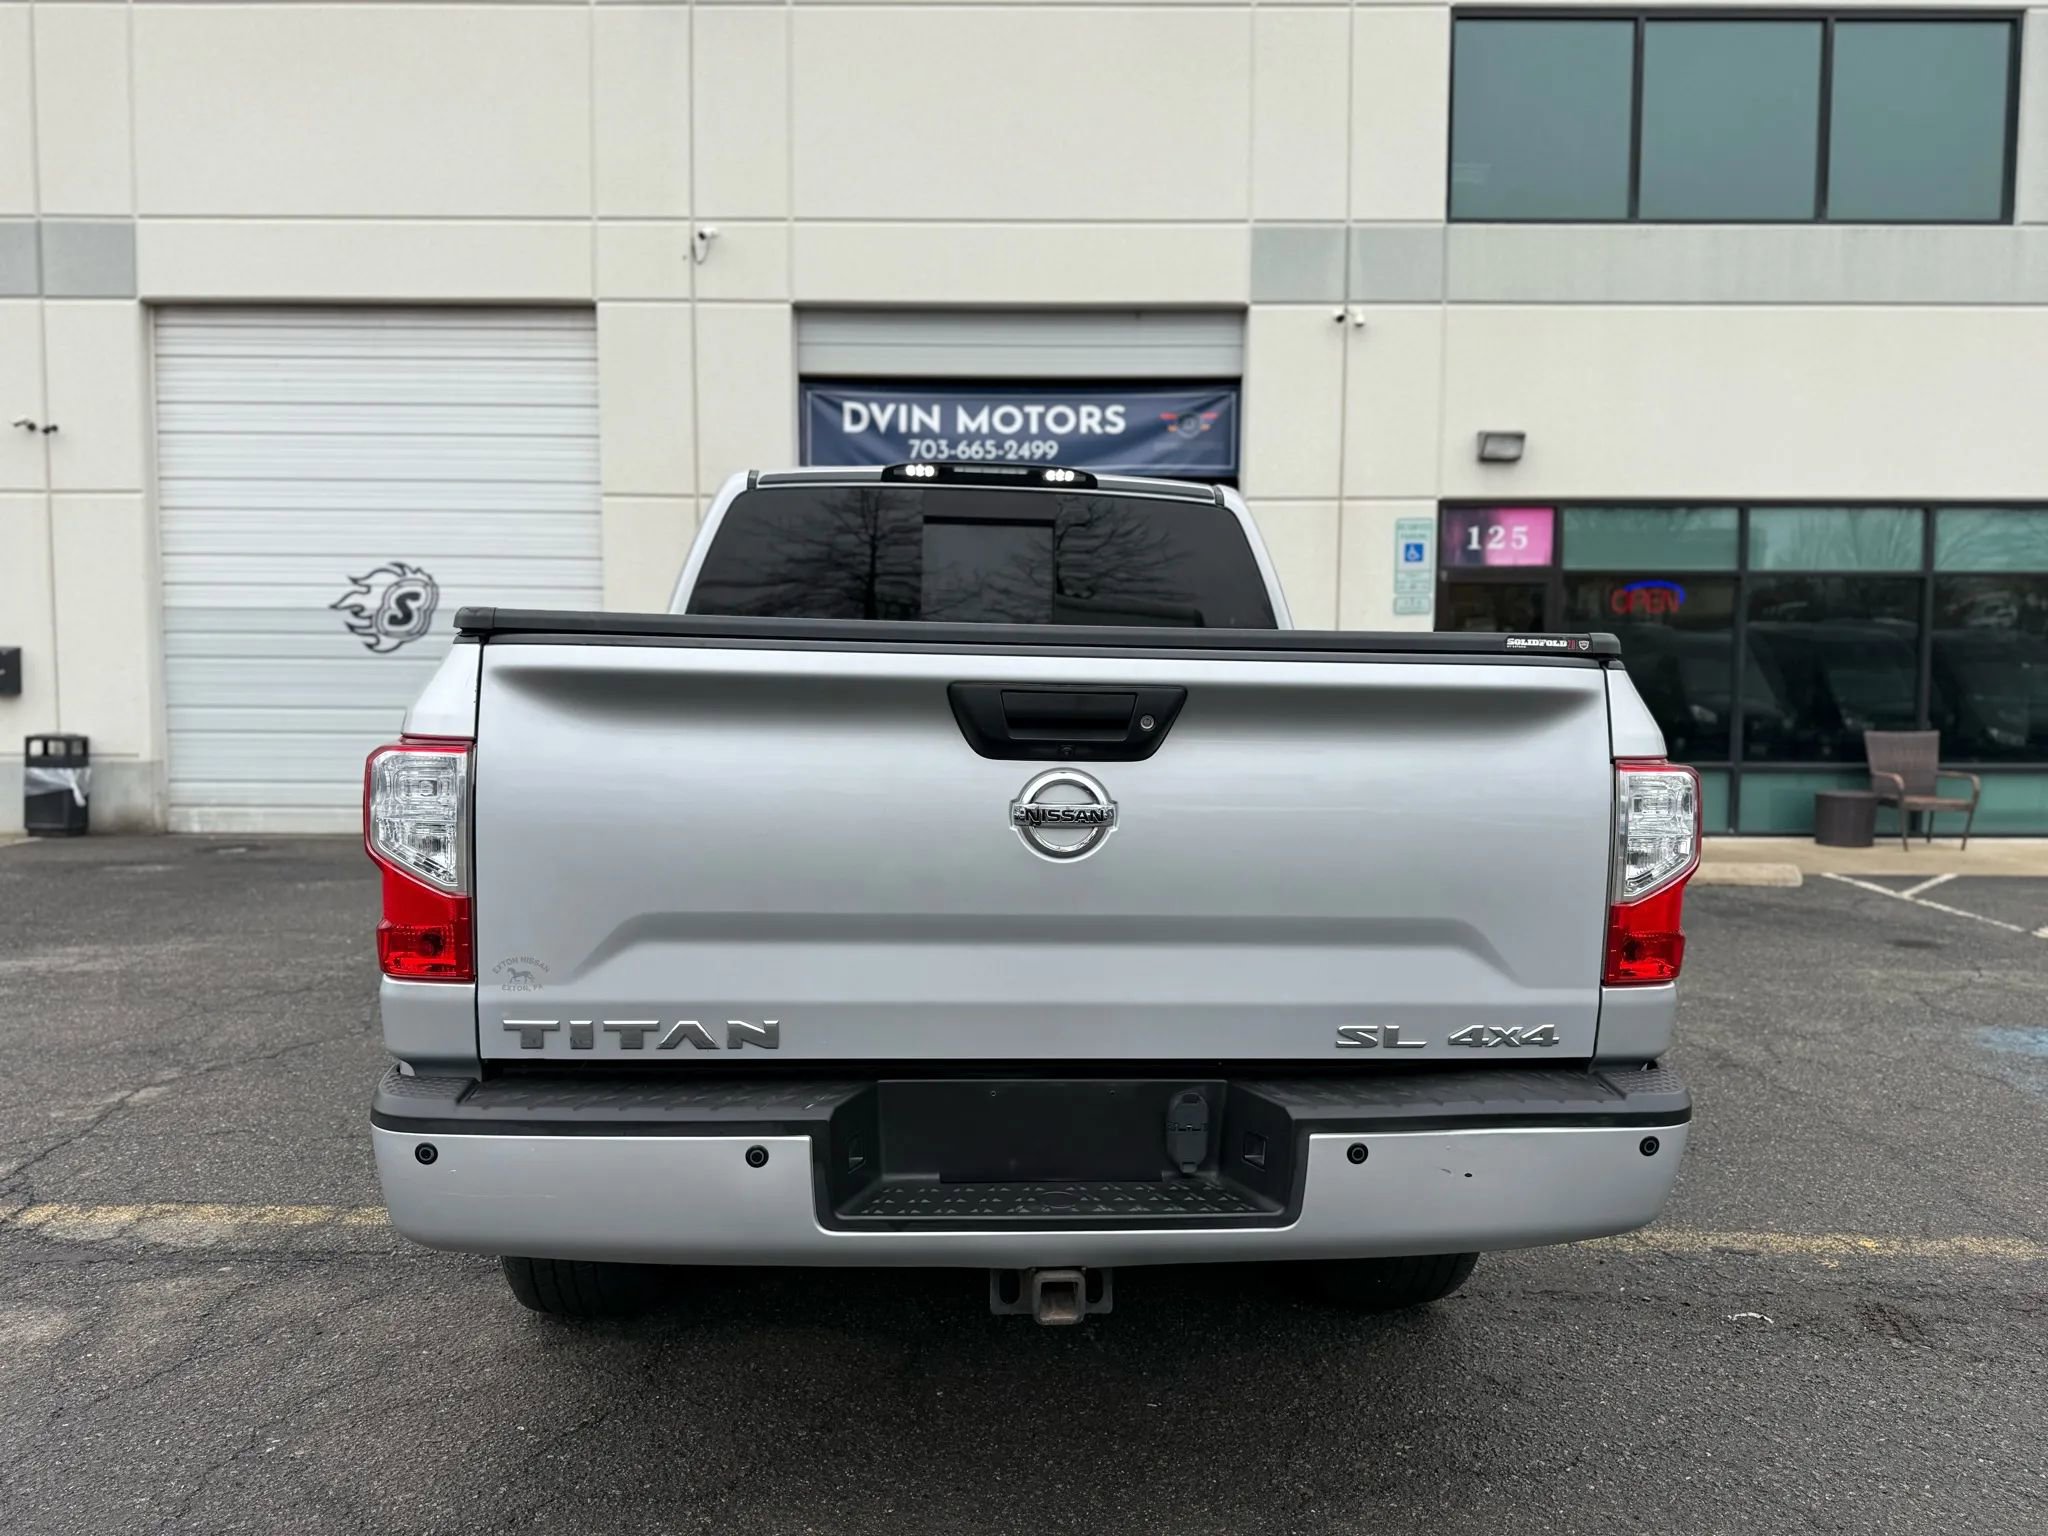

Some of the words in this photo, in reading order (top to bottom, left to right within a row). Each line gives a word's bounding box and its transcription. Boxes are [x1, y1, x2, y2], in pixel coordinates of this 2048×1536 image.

[842, 402, 941, 435] DVIN
[956, 403, 1127, 436] MOTORS
[908, 439, 1059, 461] 703-665-2499
[1466, 525, 1529, 550] 125
[387, 591, 421, 626] S
[1611, 587, 1680, 614] OPEN
[1506, 638, 1568, 648] SOLIDFOLD
[1024, 807, 1105, 823] NISSAN
[520, 956, 551, 974] NISSAN
[503, 1020, 780, 1050] TITAN
[1336, 1025, 1428, 1049] SL
